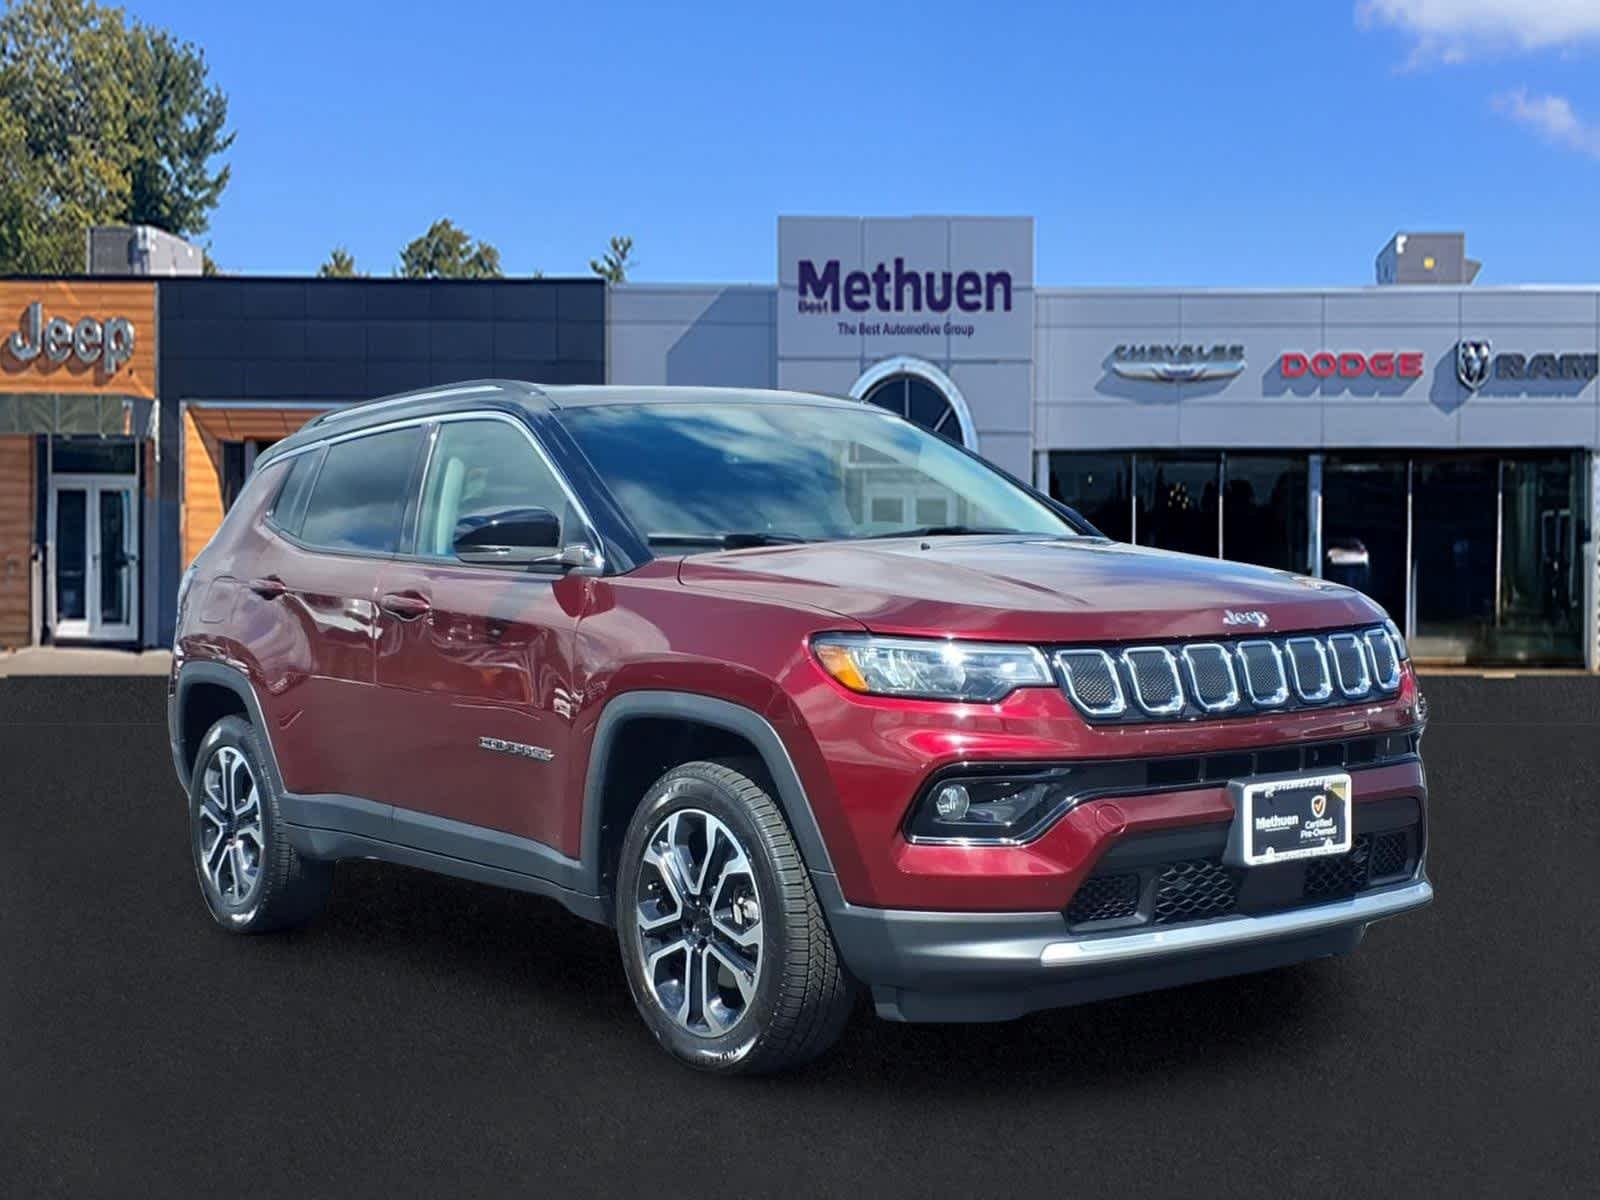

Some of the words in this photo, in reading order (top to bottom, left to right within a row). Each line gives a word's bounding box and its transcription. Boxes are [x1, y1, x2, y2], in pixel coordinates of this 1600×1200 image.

[798, 257, 1012, 312] Methuen
[9, 302, 135, 374] Jeep
[838, 322, 856, 336] The
[858, 322, 880, 336] Best
[883, 322, 941, 336] Automotive
[943, 322, 975, 339] Group
[1114, 344, 1244, 361] CHRYSLER
[1281, 352, 1423, 378] DODGE
[1494, 353, 1598, 379] RAM
[1223, 609, 1269, 628] Jeep
[1255, 814, 1299, 830] Methuen
